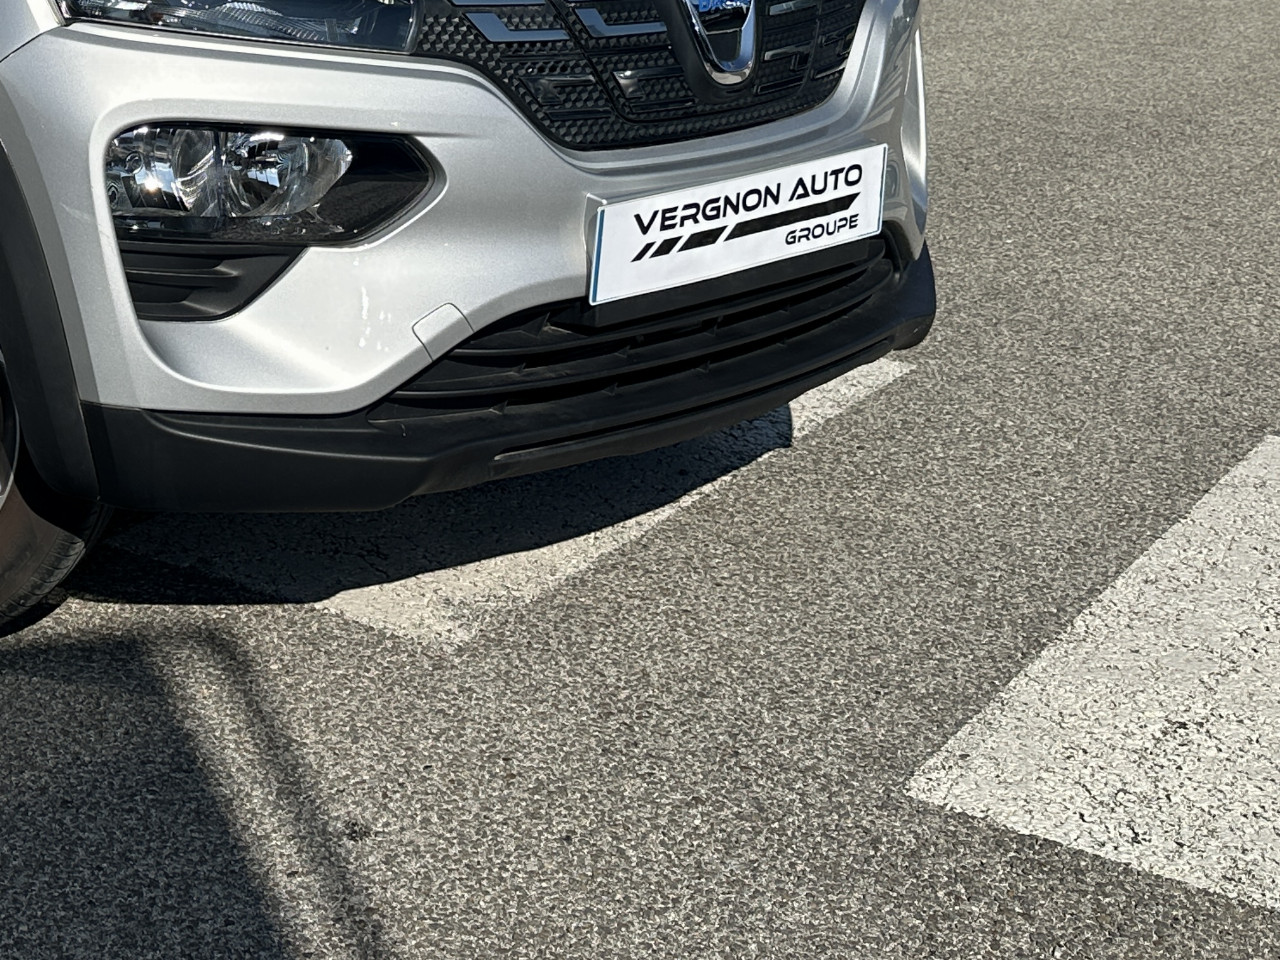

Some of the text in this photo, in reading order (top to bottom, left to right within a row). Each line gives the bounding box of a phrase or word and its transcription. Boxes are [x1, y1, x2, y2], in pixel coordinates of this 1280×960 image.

[633, 164, 863, 235] VERGNON AUTO
[785, 213, 860, 245] GROUPE
